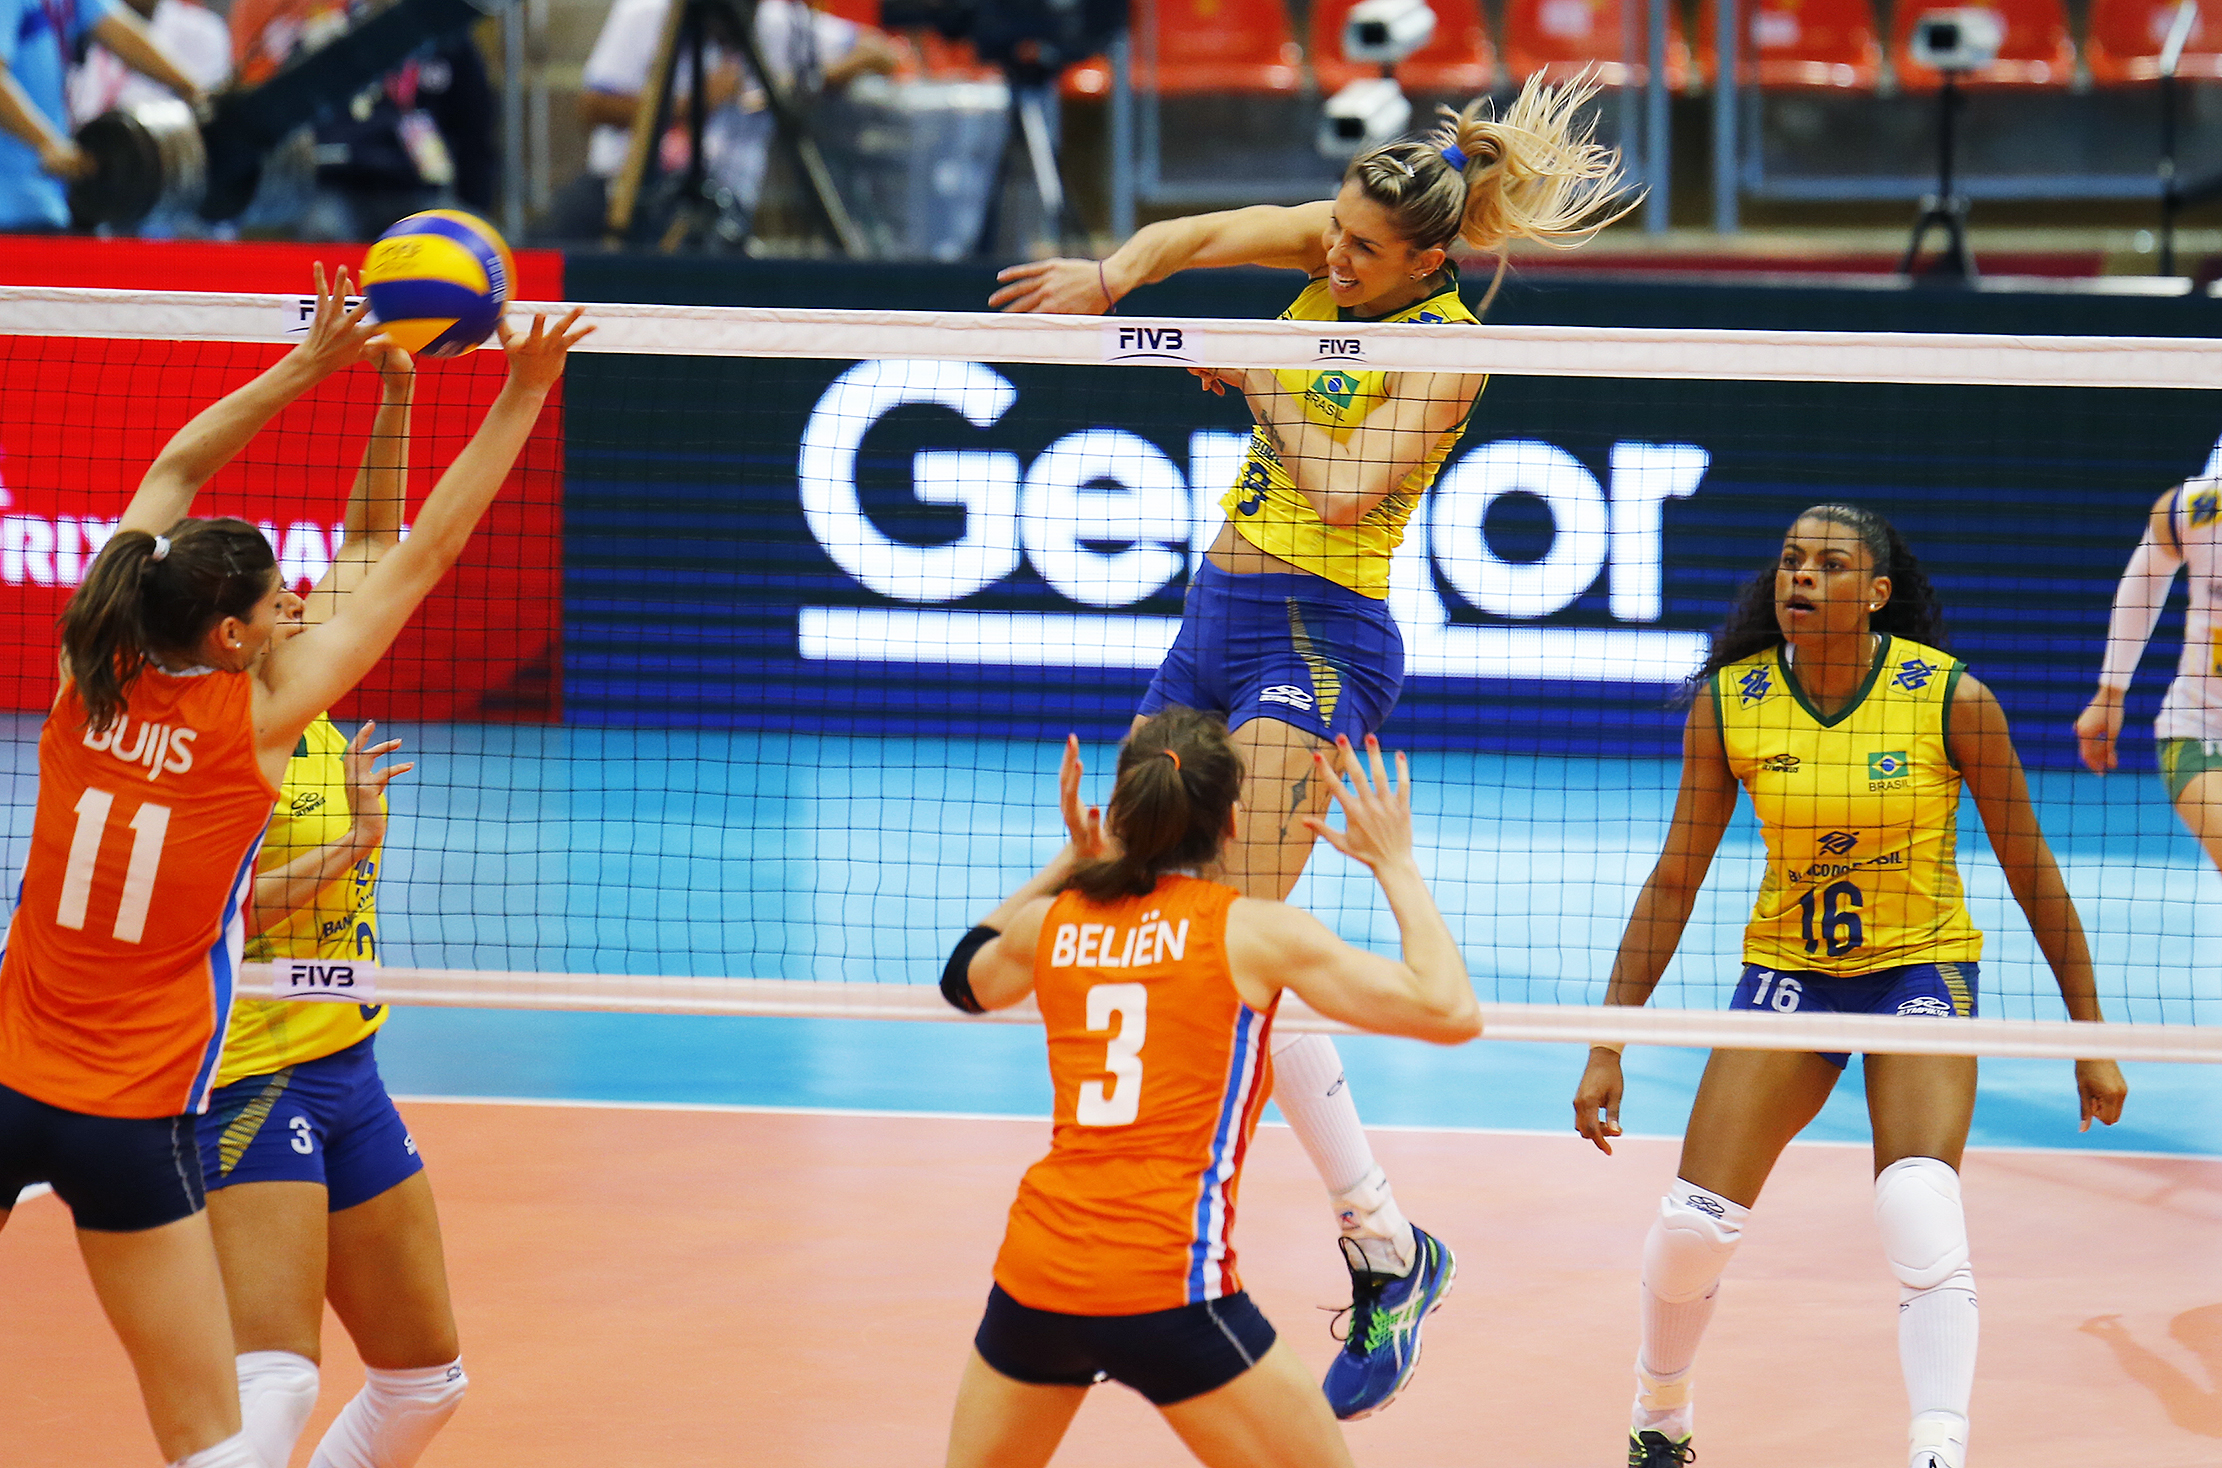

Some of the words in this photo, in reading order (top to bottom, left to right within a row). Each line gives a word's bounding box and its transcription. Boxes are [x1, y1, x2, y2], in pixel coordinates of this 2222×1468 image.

[803, 357, 1713, 620] Geor
[82, 714, 198, 782] BUIJS
[1869, 779, 1912, 792] BRASIL
[56, 786, 172, 944] 11
[1050, 909, 1190, 968] BELIËN
[1800, 880, 1863, 957] 16
[1752, 971, 1803, 1013] 16
[1076, 982, 1148, 1126] 3
[288, 1116, 314, 1155] 3
